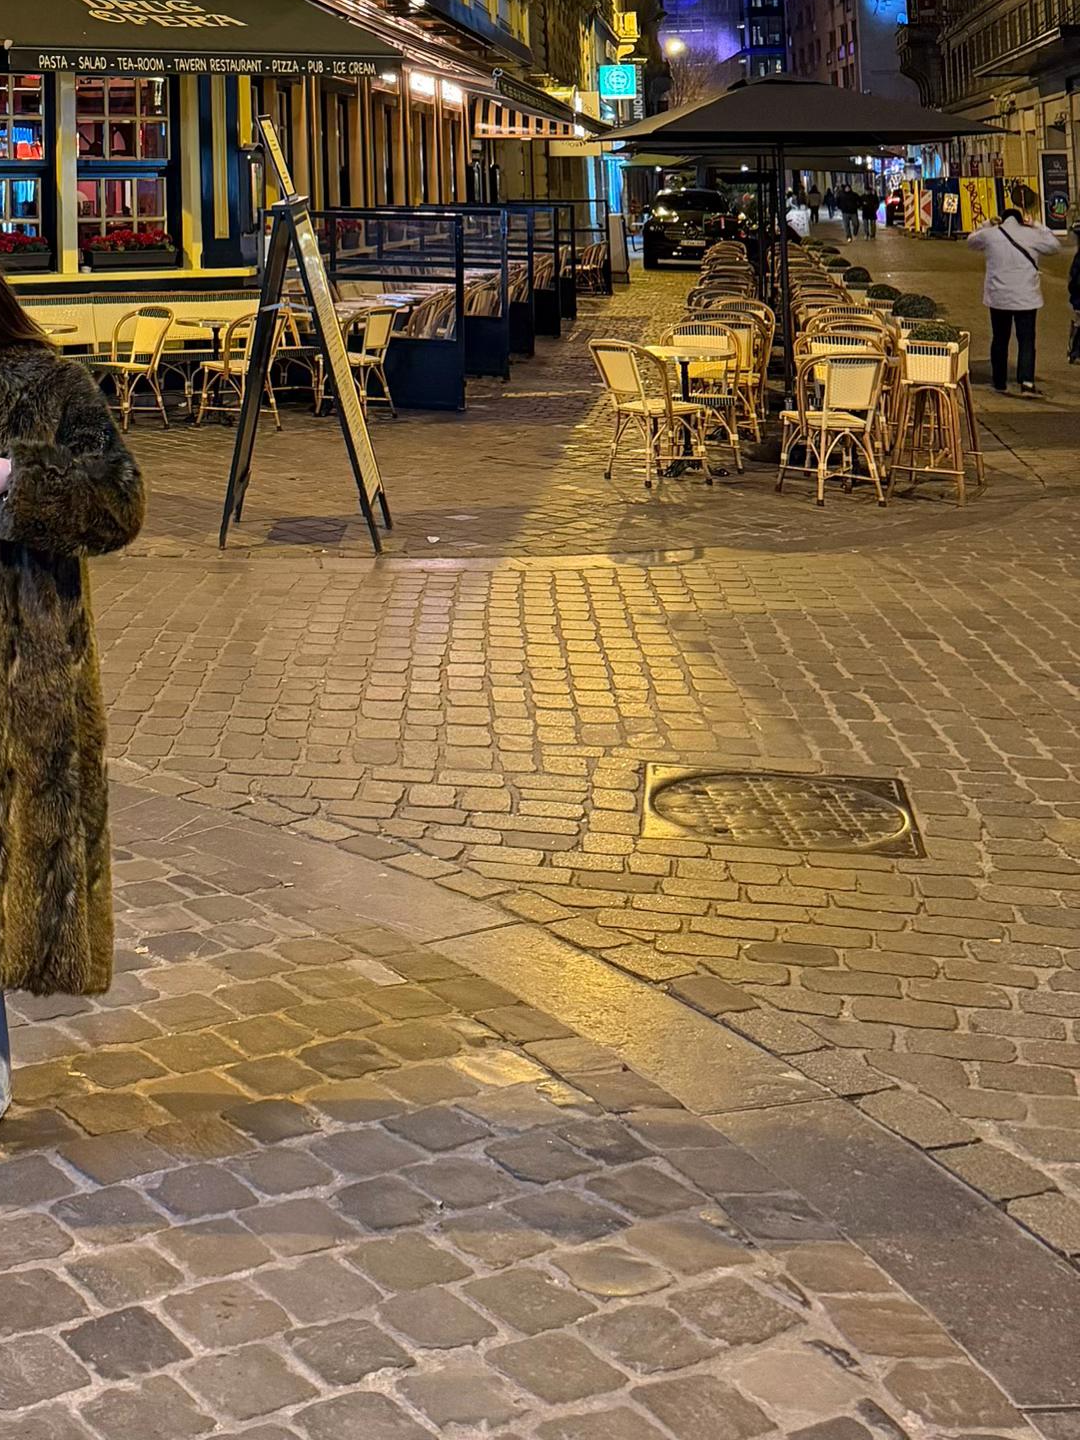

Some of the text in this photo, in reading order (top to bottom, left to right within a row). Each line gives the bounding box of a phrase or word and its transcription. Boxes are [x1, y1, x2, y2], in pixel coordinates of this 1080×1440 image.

[88, 10, 249, 28] OPERA
[38, 54, 68, 69] PASTA
[78, 56, 107, 70] SALAD
[116, 57, 165, 71] TEA-ROOM
[173, 58, 207, 72] TAVERN
[209, 58, 263, 73] RESTAURANT
[271, 60, 299, 73] PIZZA
[307, 61, 324, 74] PUB
[332, 61, 347, 74] ICE
[348, 62, 377, 75] CREAM
